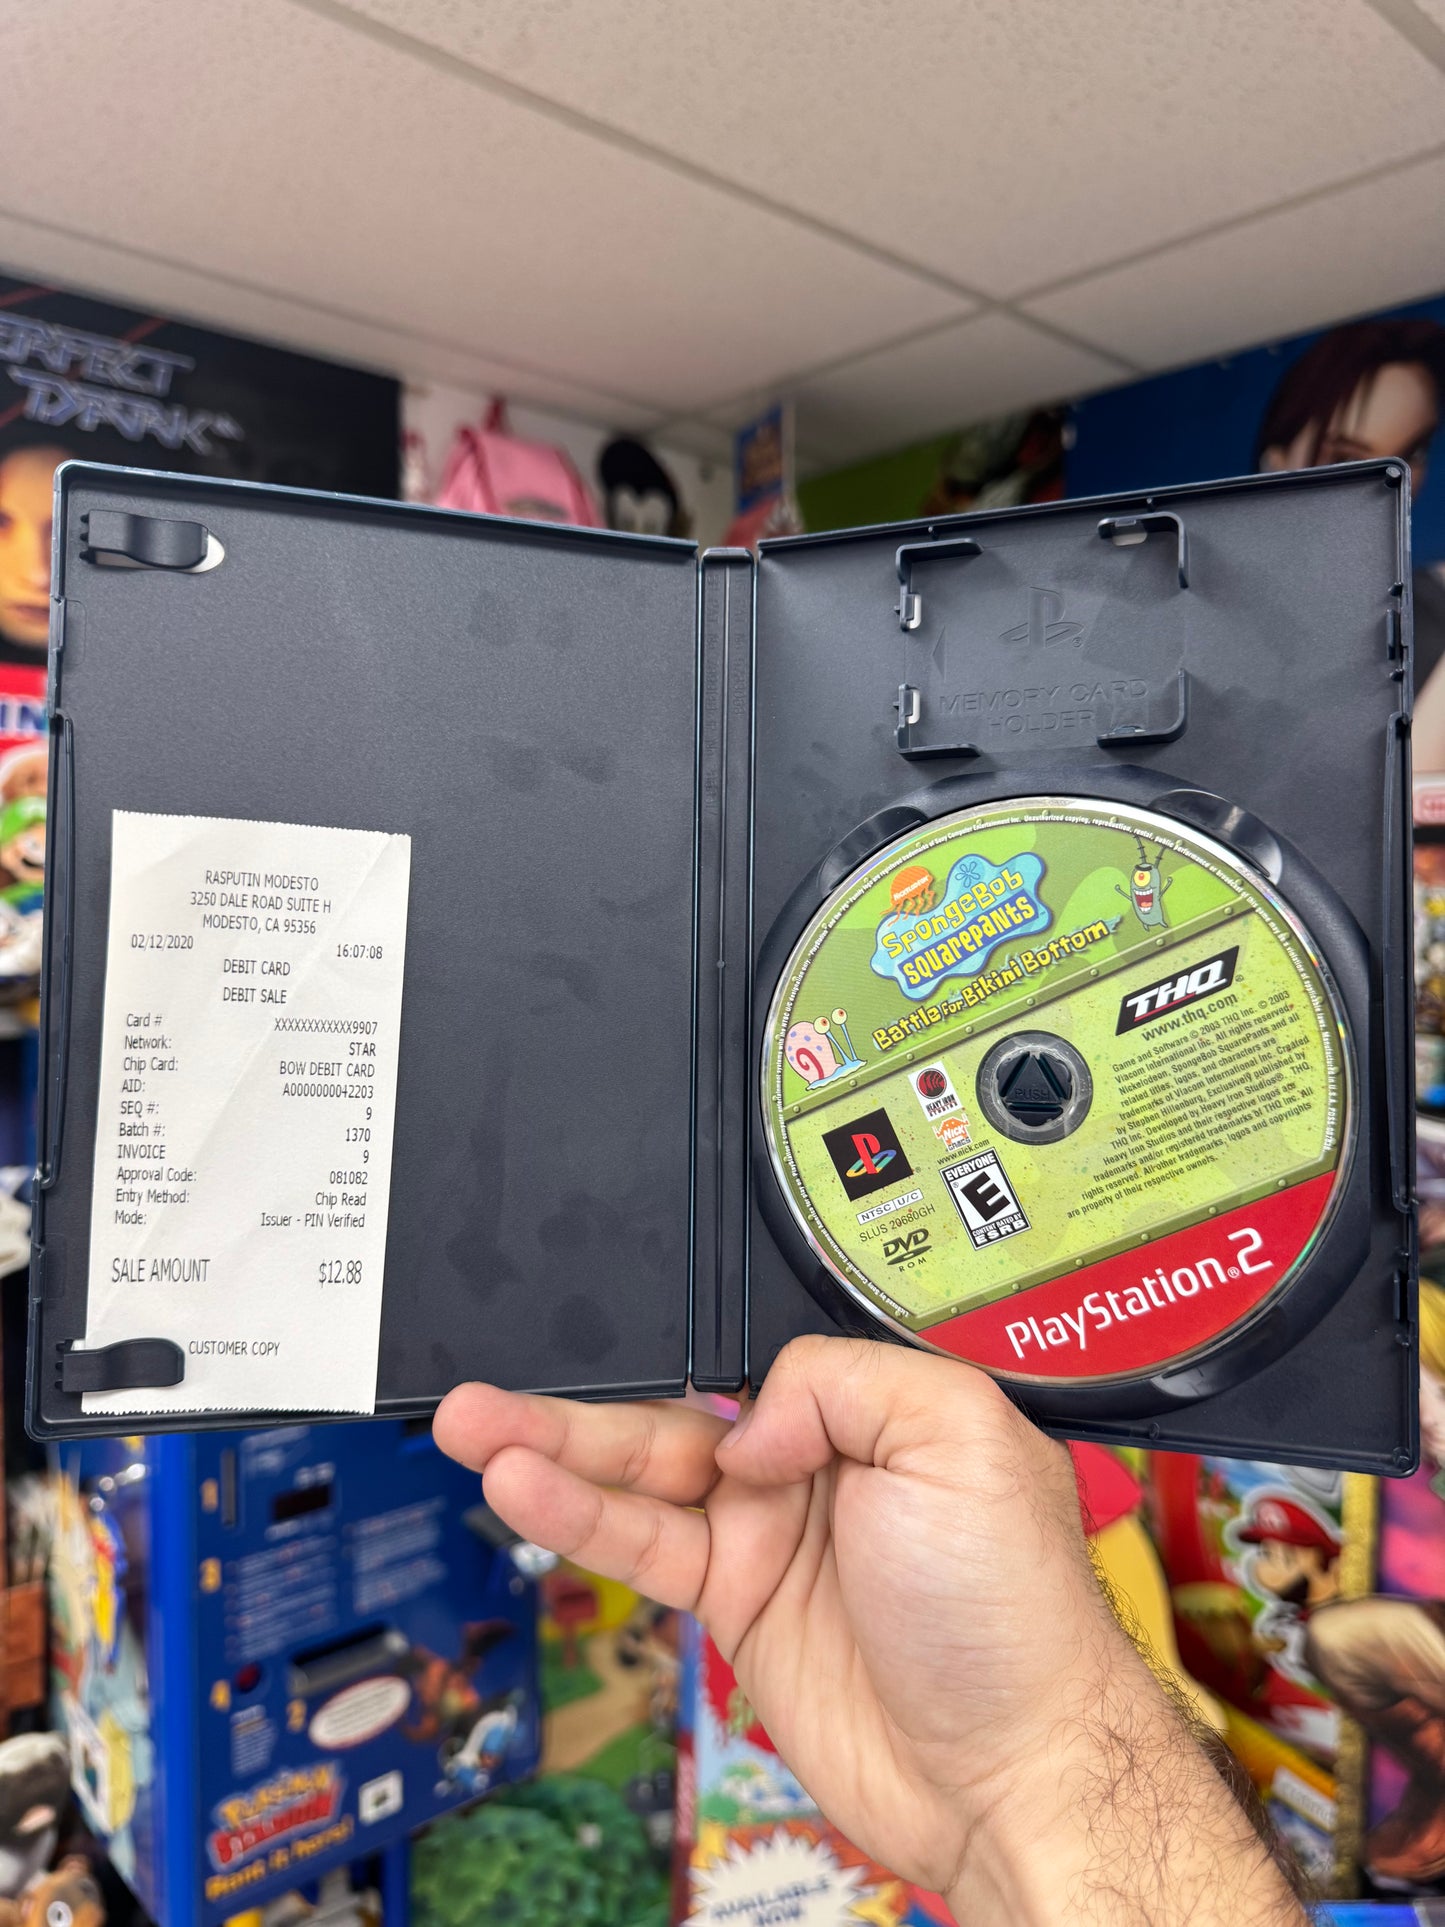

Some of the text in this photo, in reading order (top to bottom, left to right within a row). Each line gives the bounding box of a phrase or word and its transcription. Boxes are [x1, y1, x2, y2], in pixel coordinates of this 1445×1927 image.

[938, 678, 1149, 715] MEMORY CARD
[988, 709, 1095, 736] HOLDER
[205, 869, 319, 891] RASPUTIN MODESTO
[190, 890, 331, 913] 3250 DALE ROAD SUITE H
[202, 913, 316, 934] MODESTO, CA 95356
[882, 869, 1024, 959] SpongeBob
[131, 933, 194, 951] 02/12/2020
[336, 943, 383, 959] 16:07:08
[223, 958, 291, 976] DEBIT CARD
[872, 1005, 941, 1050] Battle
[961, 959, 1023, 1007] Bikini
[1020, 919, 1109, 973] Bottom
[1126, 960, 1228, 1020] THQ
[222, 986, 287, 1004] DEBIT SALE
[125, 1012, 163, 1027] Card #
[274, 1017, 377, 1035] XXXXXXXXXXXX9907
[1141, 993, 1238, 1041] www.thq.com
[1112, 990, 1290, 1072] Game and Software © 2003 THQ Inc. © 2003
[124, 1034, 171, 1050] Network:
[348, 1041, 376, 1057] STAR
[1114, 1003, 1292, 1083] Viacom International Inc. All rights reserved.
[1118, 1012, 1300, 1095] Nickelodeon, SpongeBob SquarePants and all
[123, 1056, 178, 1075] Chip Card:
[279, 1060, 375, 1078] BOW DEBIT CARD
[1120, 1037, 1277, 1107] related titles, logos, and characters are
[121, 1078, 145, 1093] AID:
[1118, 1035, 1310, 1120] trademarks of Viacom International Inc. Created
[282, 1082, 373, 1099] A0000000042203
[1015, 1088, 1050, 1100] PUSH
[1115, 1051, 1306, 1135] by Stephen Hillenburg, Exclusively published by
[120, 1100, 159, 1118] SEQ #:
[365, 1106, 372, 1121] 9
[118, 1121, 165, 1137] Batch #:
[345, 1127, 371, 1142] 1370
[117, 1143, 166, 1159] INVOICE
[362, 1149, 370, 1164] 9
[937, 1139, 990, 1165] www.nick.com
[116, 1166, 197, 1184] Approval Code:
[945, 1152, 996, 1181] EVERYONE
[329, 1170, 368, 1185] 081082
[115, 1187, 190, 1206] Entry Method:
[315, 1191, 367, 1210] Chip Read
[960, 1171, 1011, 1222] E
[861, 1192, 919, 1221] NTSC U/C
[114, 1209, 147, 1225] Mode:
[260, 1212, 292, 1227] Issuer
[304, 1212, 324, 1227] PIN
[327, 1212, 365, 1228] Verified
[859, 1204, 936, 1243] SLUS 20680GH
[972, 1212, 1022, 1237] CONTENT RATED BY
[974, 1218, 1026, 1245] ESRB
[882, 1228, 929, 1258] DVD
[111, 1257, 210, 1283] SALE AMOUNT
[318, 1259, 362, 1288] $12.88
[899, 1256, 927, 1272] ROM
[1005, 1256, 1228, 1359] PlayStation
[188, 1340, 280, 1356] CUSTOMER COPY
